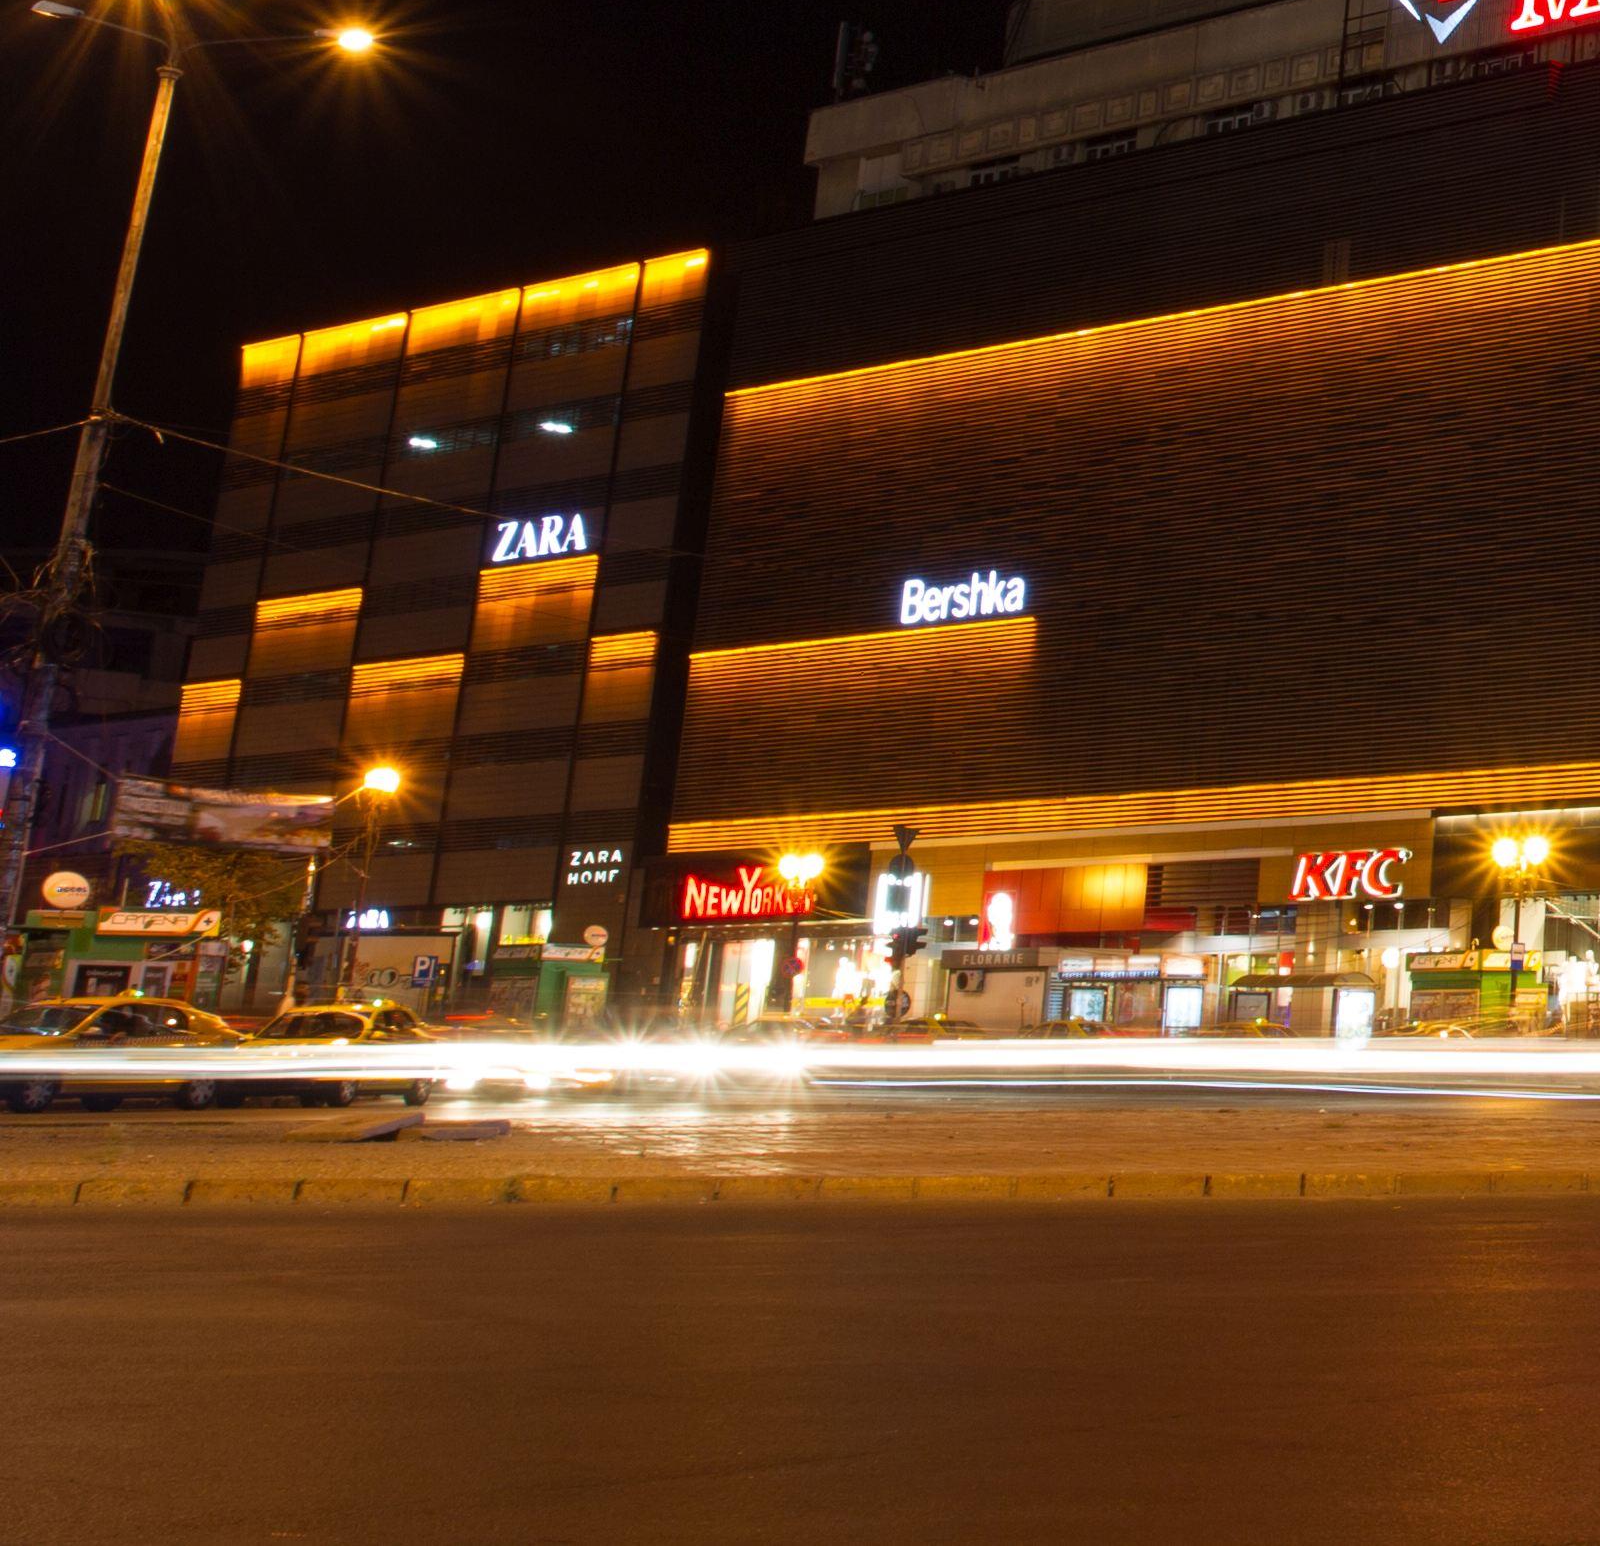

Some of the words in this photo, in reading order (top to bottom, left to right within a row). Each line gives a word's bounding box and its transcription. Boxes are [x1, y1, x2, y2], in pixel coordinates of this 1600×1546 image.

[492, 514, 587, 562] ZARA
[901, 570, 1026, 624] Bershka
[570, 849, 622, 866] ZARA
[1288, 849, 1404, 901] KFC
[962, 953, 1025, 967] FLORARIE
